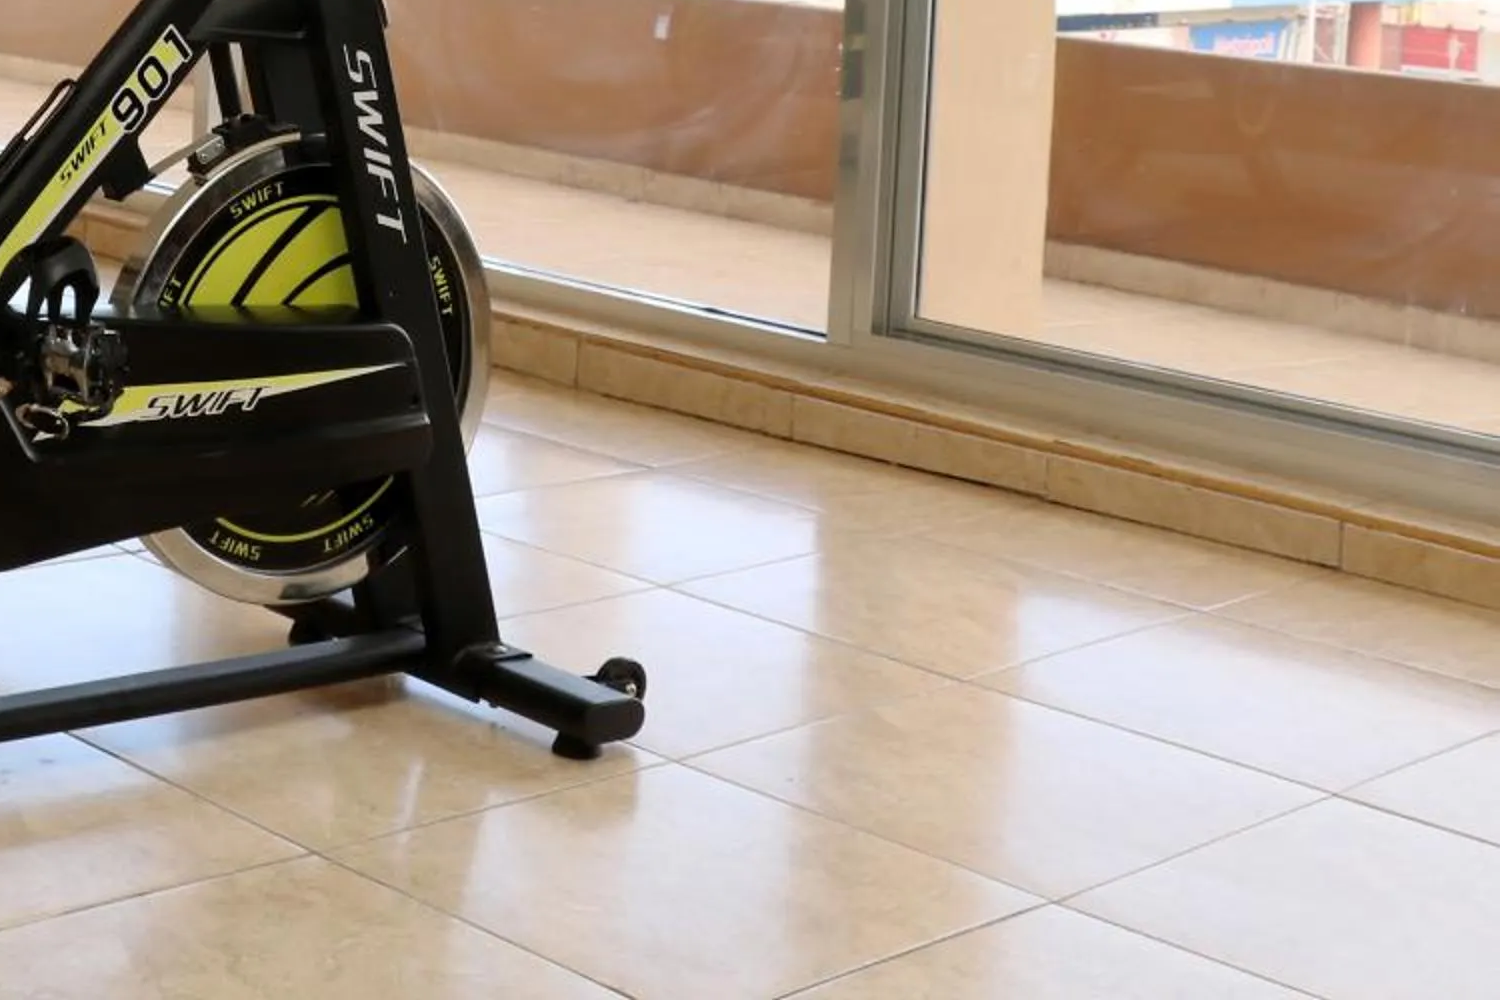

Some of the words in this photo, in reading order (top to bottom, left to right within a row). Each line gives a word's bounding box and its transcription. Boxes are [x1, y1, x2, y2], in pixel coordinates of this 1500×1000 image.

[58, 116, 108, 187] SWIFT
[109, 23, 194, 135] 901
[343, 43, 408, 245] SWIFT
[229, 180, 286, 221] SWIFT
[427, 254, 454, 317] SWIFT
[141, 386, 270, 420] SWIFT
[207, 531, 262, 562] SWIFT
[322, 513, 376, 554] SWIFT
